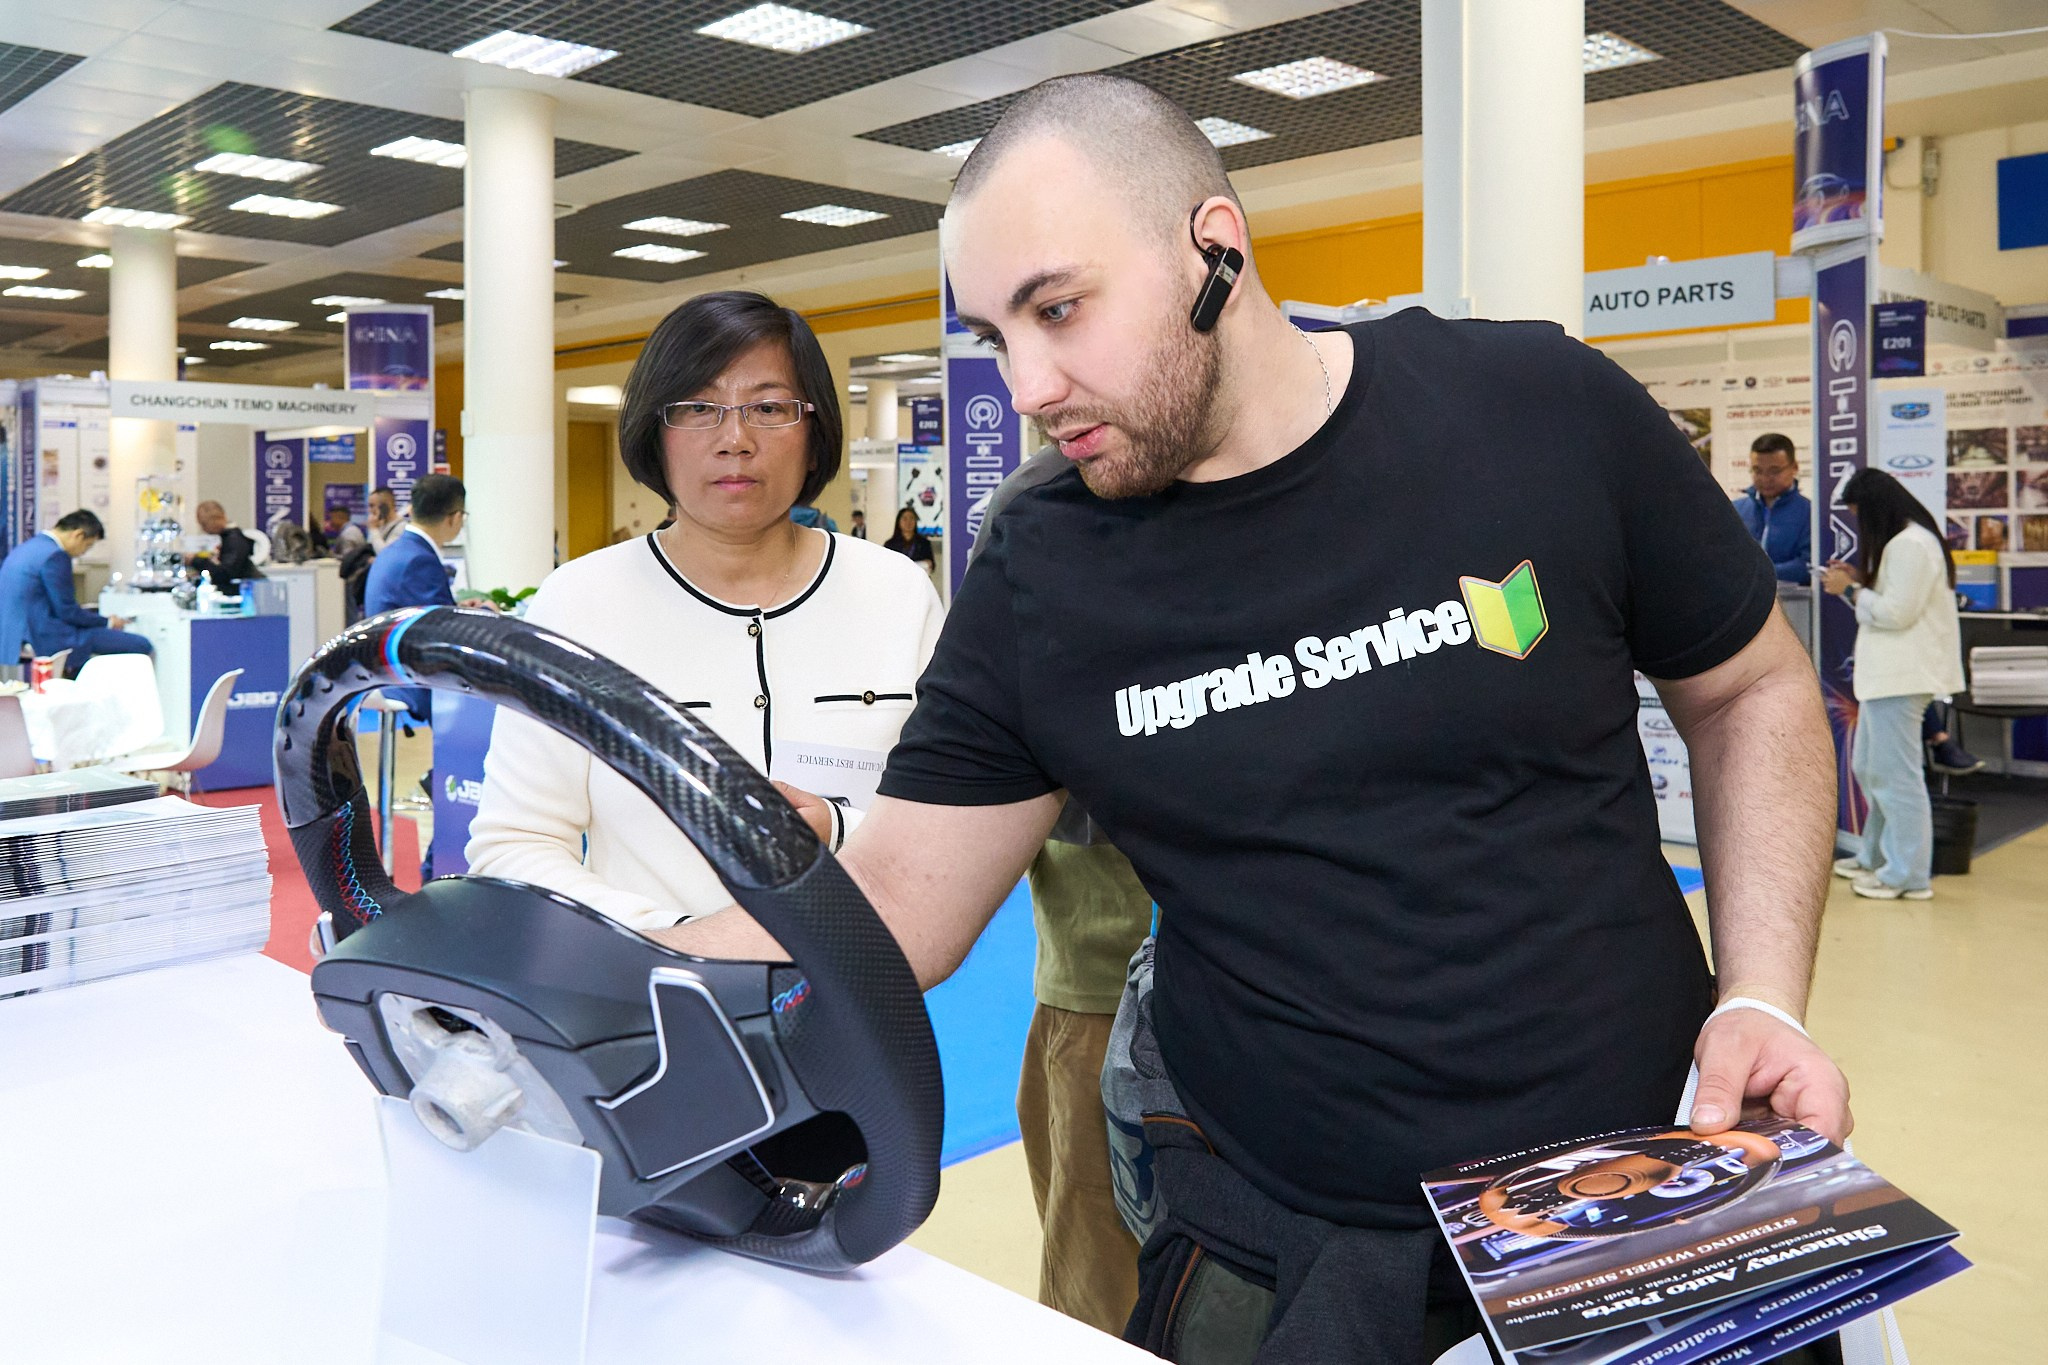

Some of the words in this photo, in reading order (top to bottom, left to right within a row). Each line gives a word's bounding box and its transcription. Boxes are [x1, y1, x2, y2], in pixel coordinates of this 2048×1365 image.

[1589, 289, 1650, 312] AUTO
[1657, 281, 1734, 306] PARTS
[355, 325, 418, 344] CHINA
[1882, 337, 1912, 350] E201
[130, 394, 228, 410] CHANGCHUN
[233, 398, 273, 412] TEMO
[276, 400, 357, 415] MACHINERY
[965, 394, 1004, 561] CHIN
[1115, 652, 1297, 737] Upgrade
[1294, 600, 1472, 689] Service
[796, 753, 835, 767] SERVICE
[836, 758, 854, 770] BEST
[1696, 1216, 1798, 1255] STEERING
[1770, 1226, 1837, 1250] Mercedes
[1735, 1246, 1770, 1261] Benz
[1745, 1224, 1889, 1273] Shineway
[1619, 1249, 1696, 1277] WHEEL
[1506, 1272, 1618, 1309] SELECTION
[1665, 1266, 1738, 1296] Auto
[1570, 1299, 1595, 1311] VW
[1581, 1290, 1665, 1320] Parts
[1603, 1287, 1635, 1303] Audi
[1505, 1308, 1560, 1326] Porsche
